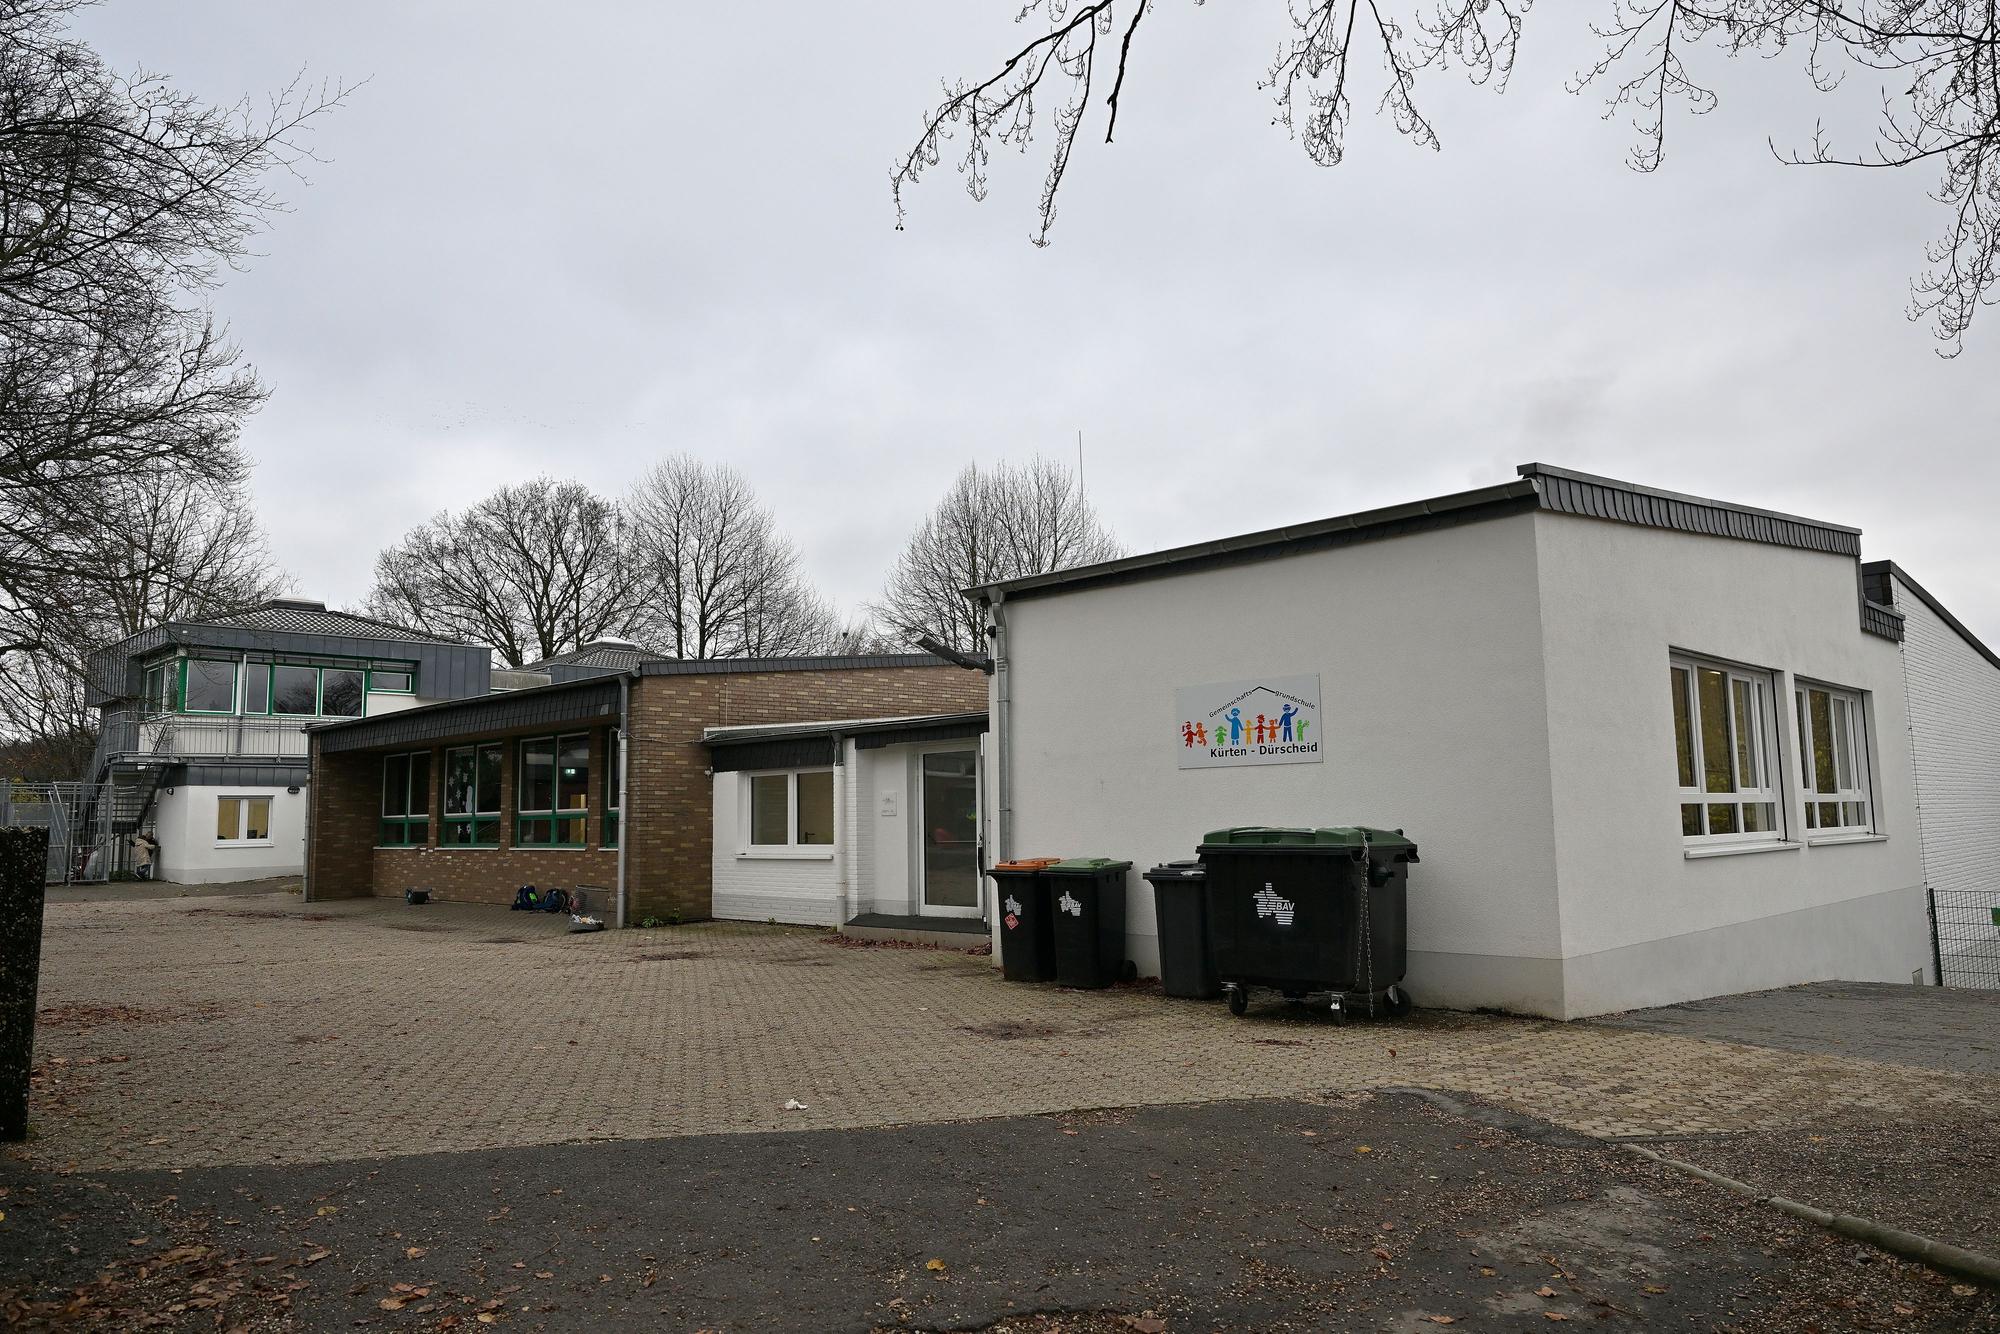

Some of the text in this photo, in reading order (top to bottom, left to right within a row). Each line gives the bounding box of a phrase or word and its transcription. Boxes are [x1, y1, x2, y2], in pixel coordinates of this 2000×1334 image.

[1209, 690, 1315, 717] Gemeinschafts grundschule
[1210, 747, 1247, 757] Kürten
[1260, 742, 1318, 755] Dürscheid
[1276, 902, 1295, 911] BAV
